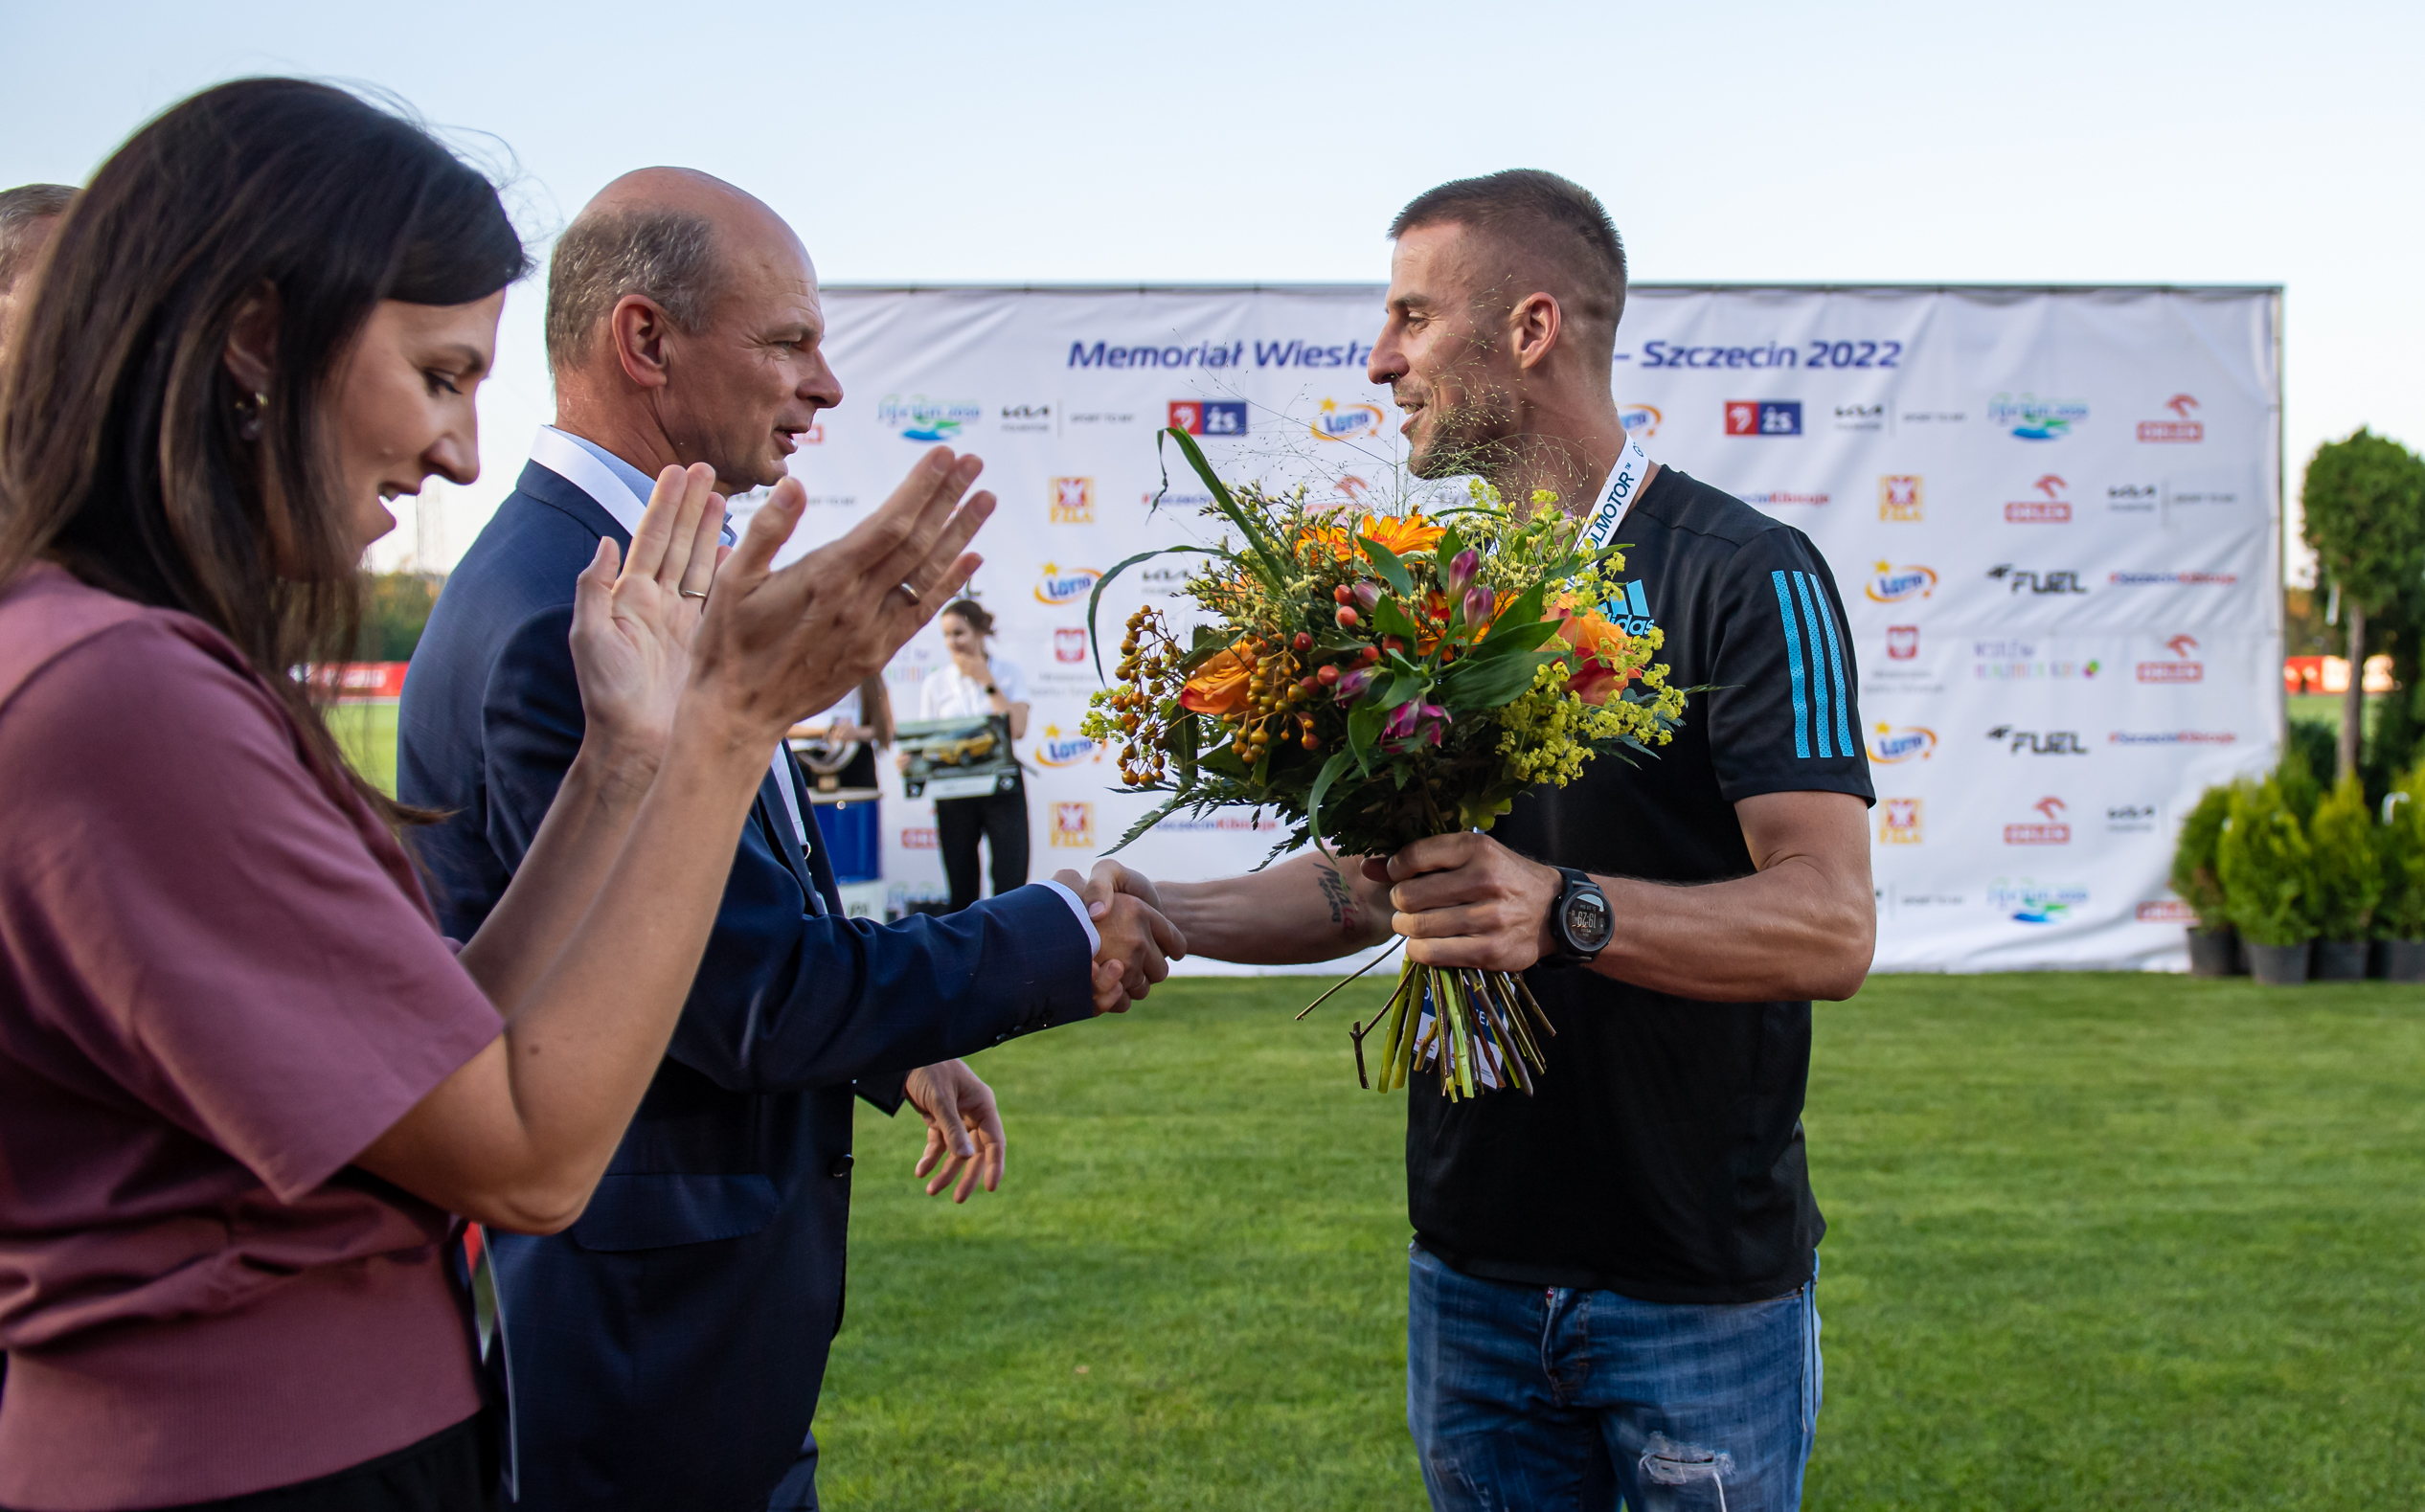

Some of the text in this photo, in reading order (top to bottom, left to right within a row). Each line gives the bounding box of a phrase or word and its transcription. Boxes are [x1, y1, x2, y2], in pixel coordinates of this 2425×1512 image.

[1067, 340, 1243, 369] Memoriał
[1255, 340, 1372, 369] Wiesła
[1641, 341, 1798, 369] Szczecin
[1806, 341, 1902, 369] 2022
